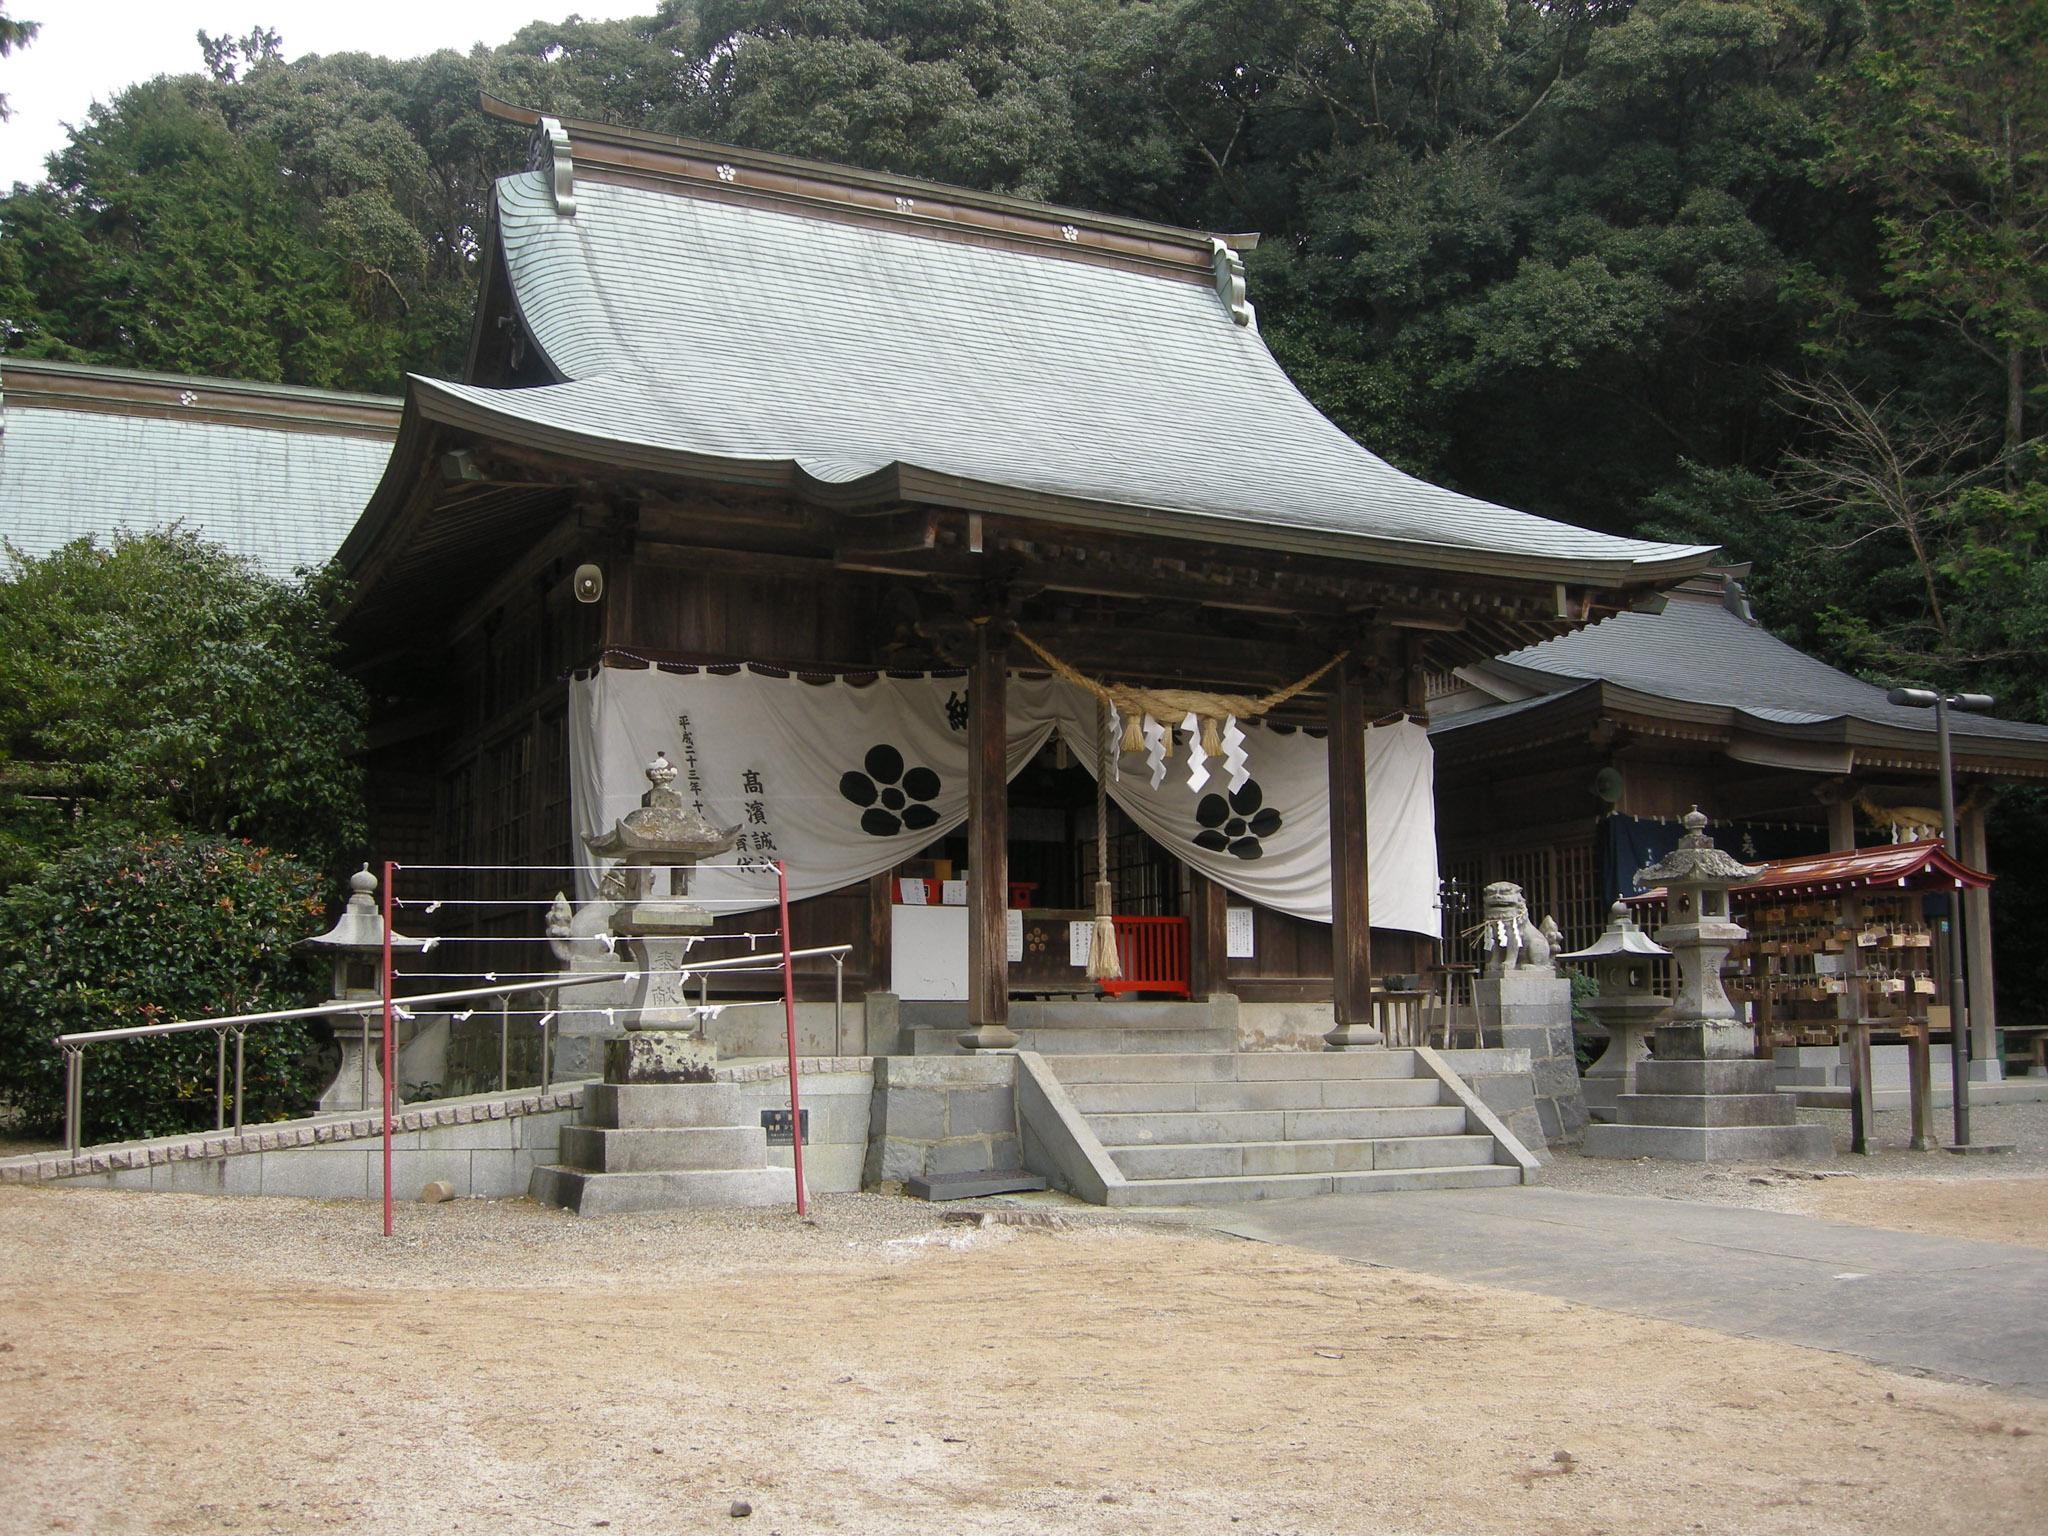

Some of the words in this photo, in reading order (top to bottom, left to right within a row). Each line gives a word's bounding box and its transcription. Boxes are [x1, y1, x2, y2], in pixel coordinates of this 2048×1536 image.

[678, 715, 706, 821] 平成二十三年十
